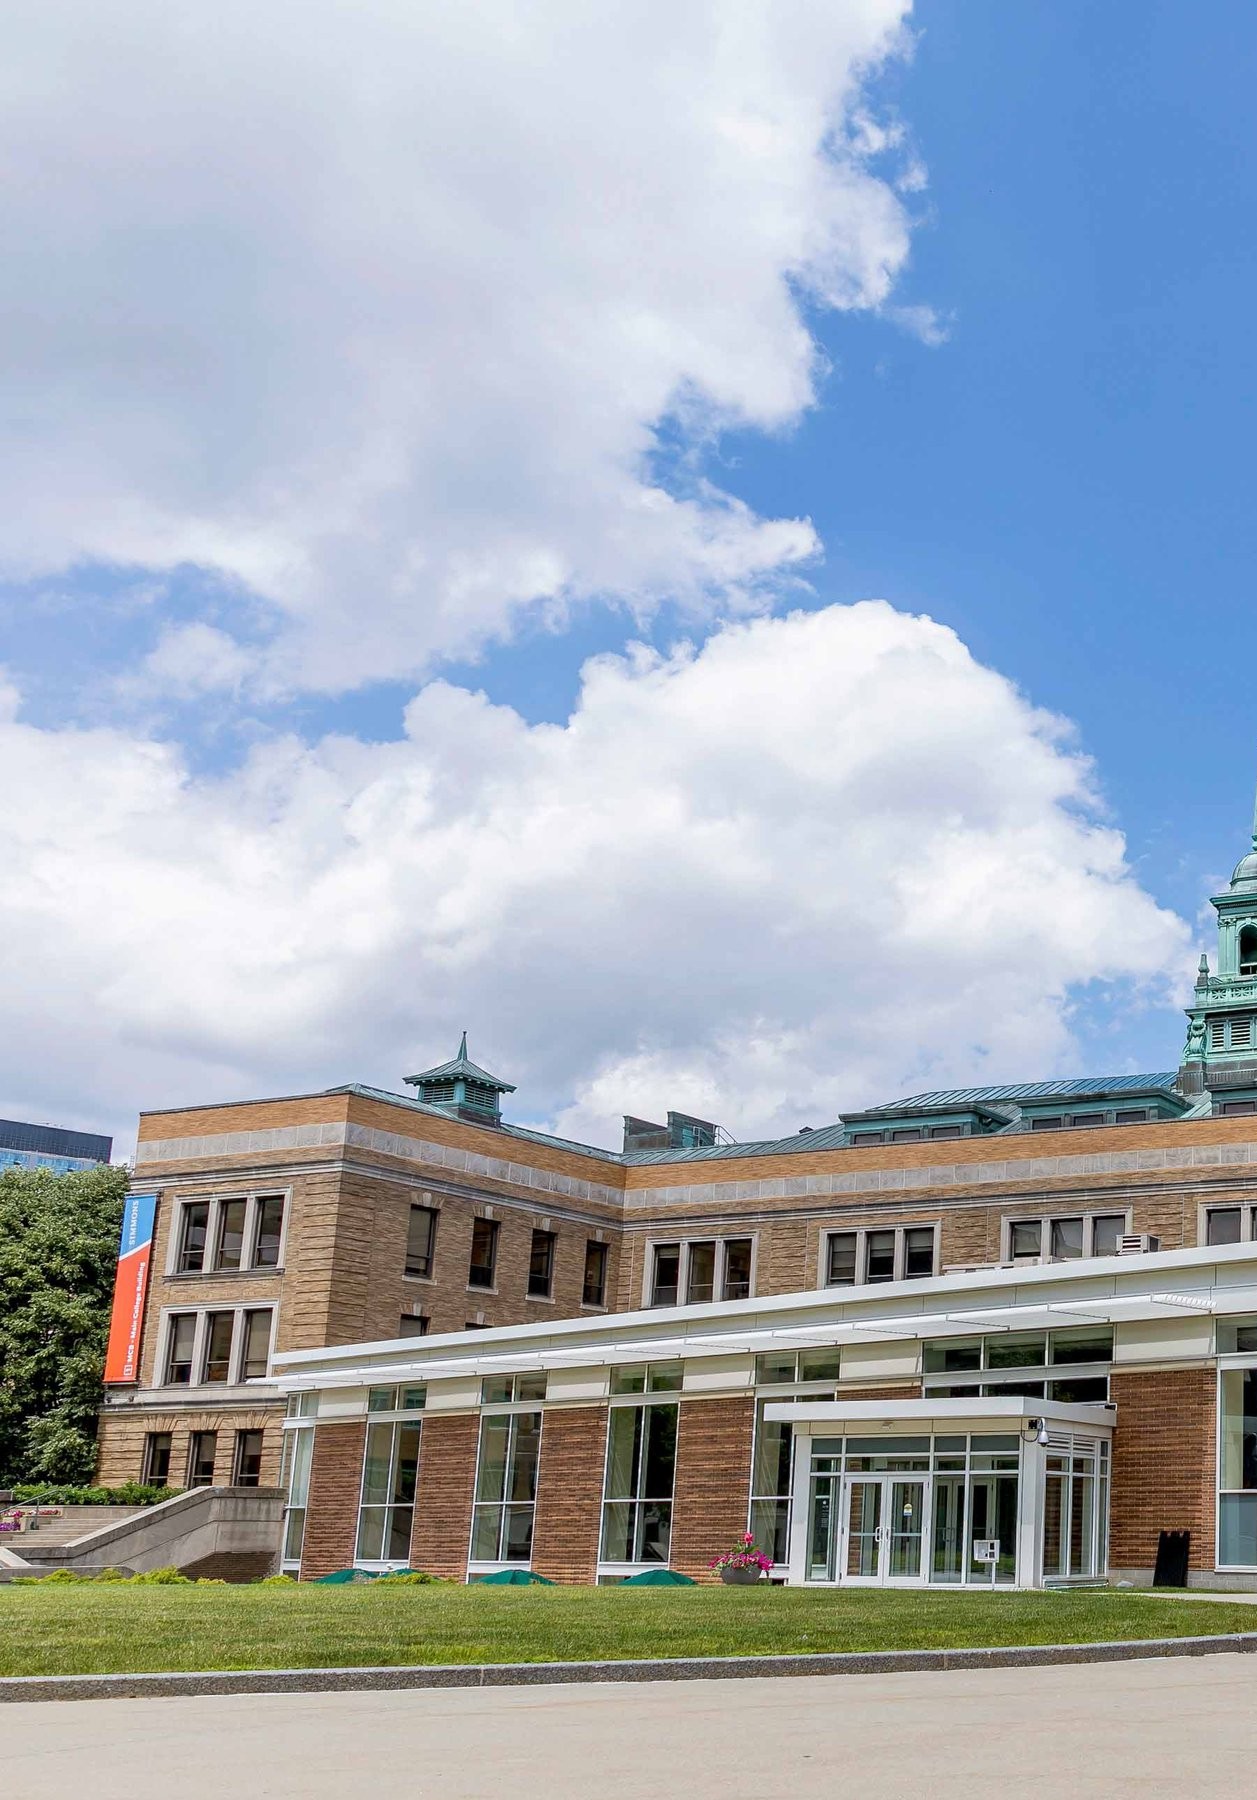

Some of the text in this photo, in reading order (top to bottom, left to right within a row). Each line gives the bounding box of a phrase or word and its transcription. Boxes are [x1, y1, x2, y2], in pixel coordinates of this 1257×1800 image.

[128, 1200, 139, 1245] SIMMONS
[136, 1262, 146, 1291] Building
[132, 1292, 142, 1319] College
[127, 1344, 135, 1363] MCB
